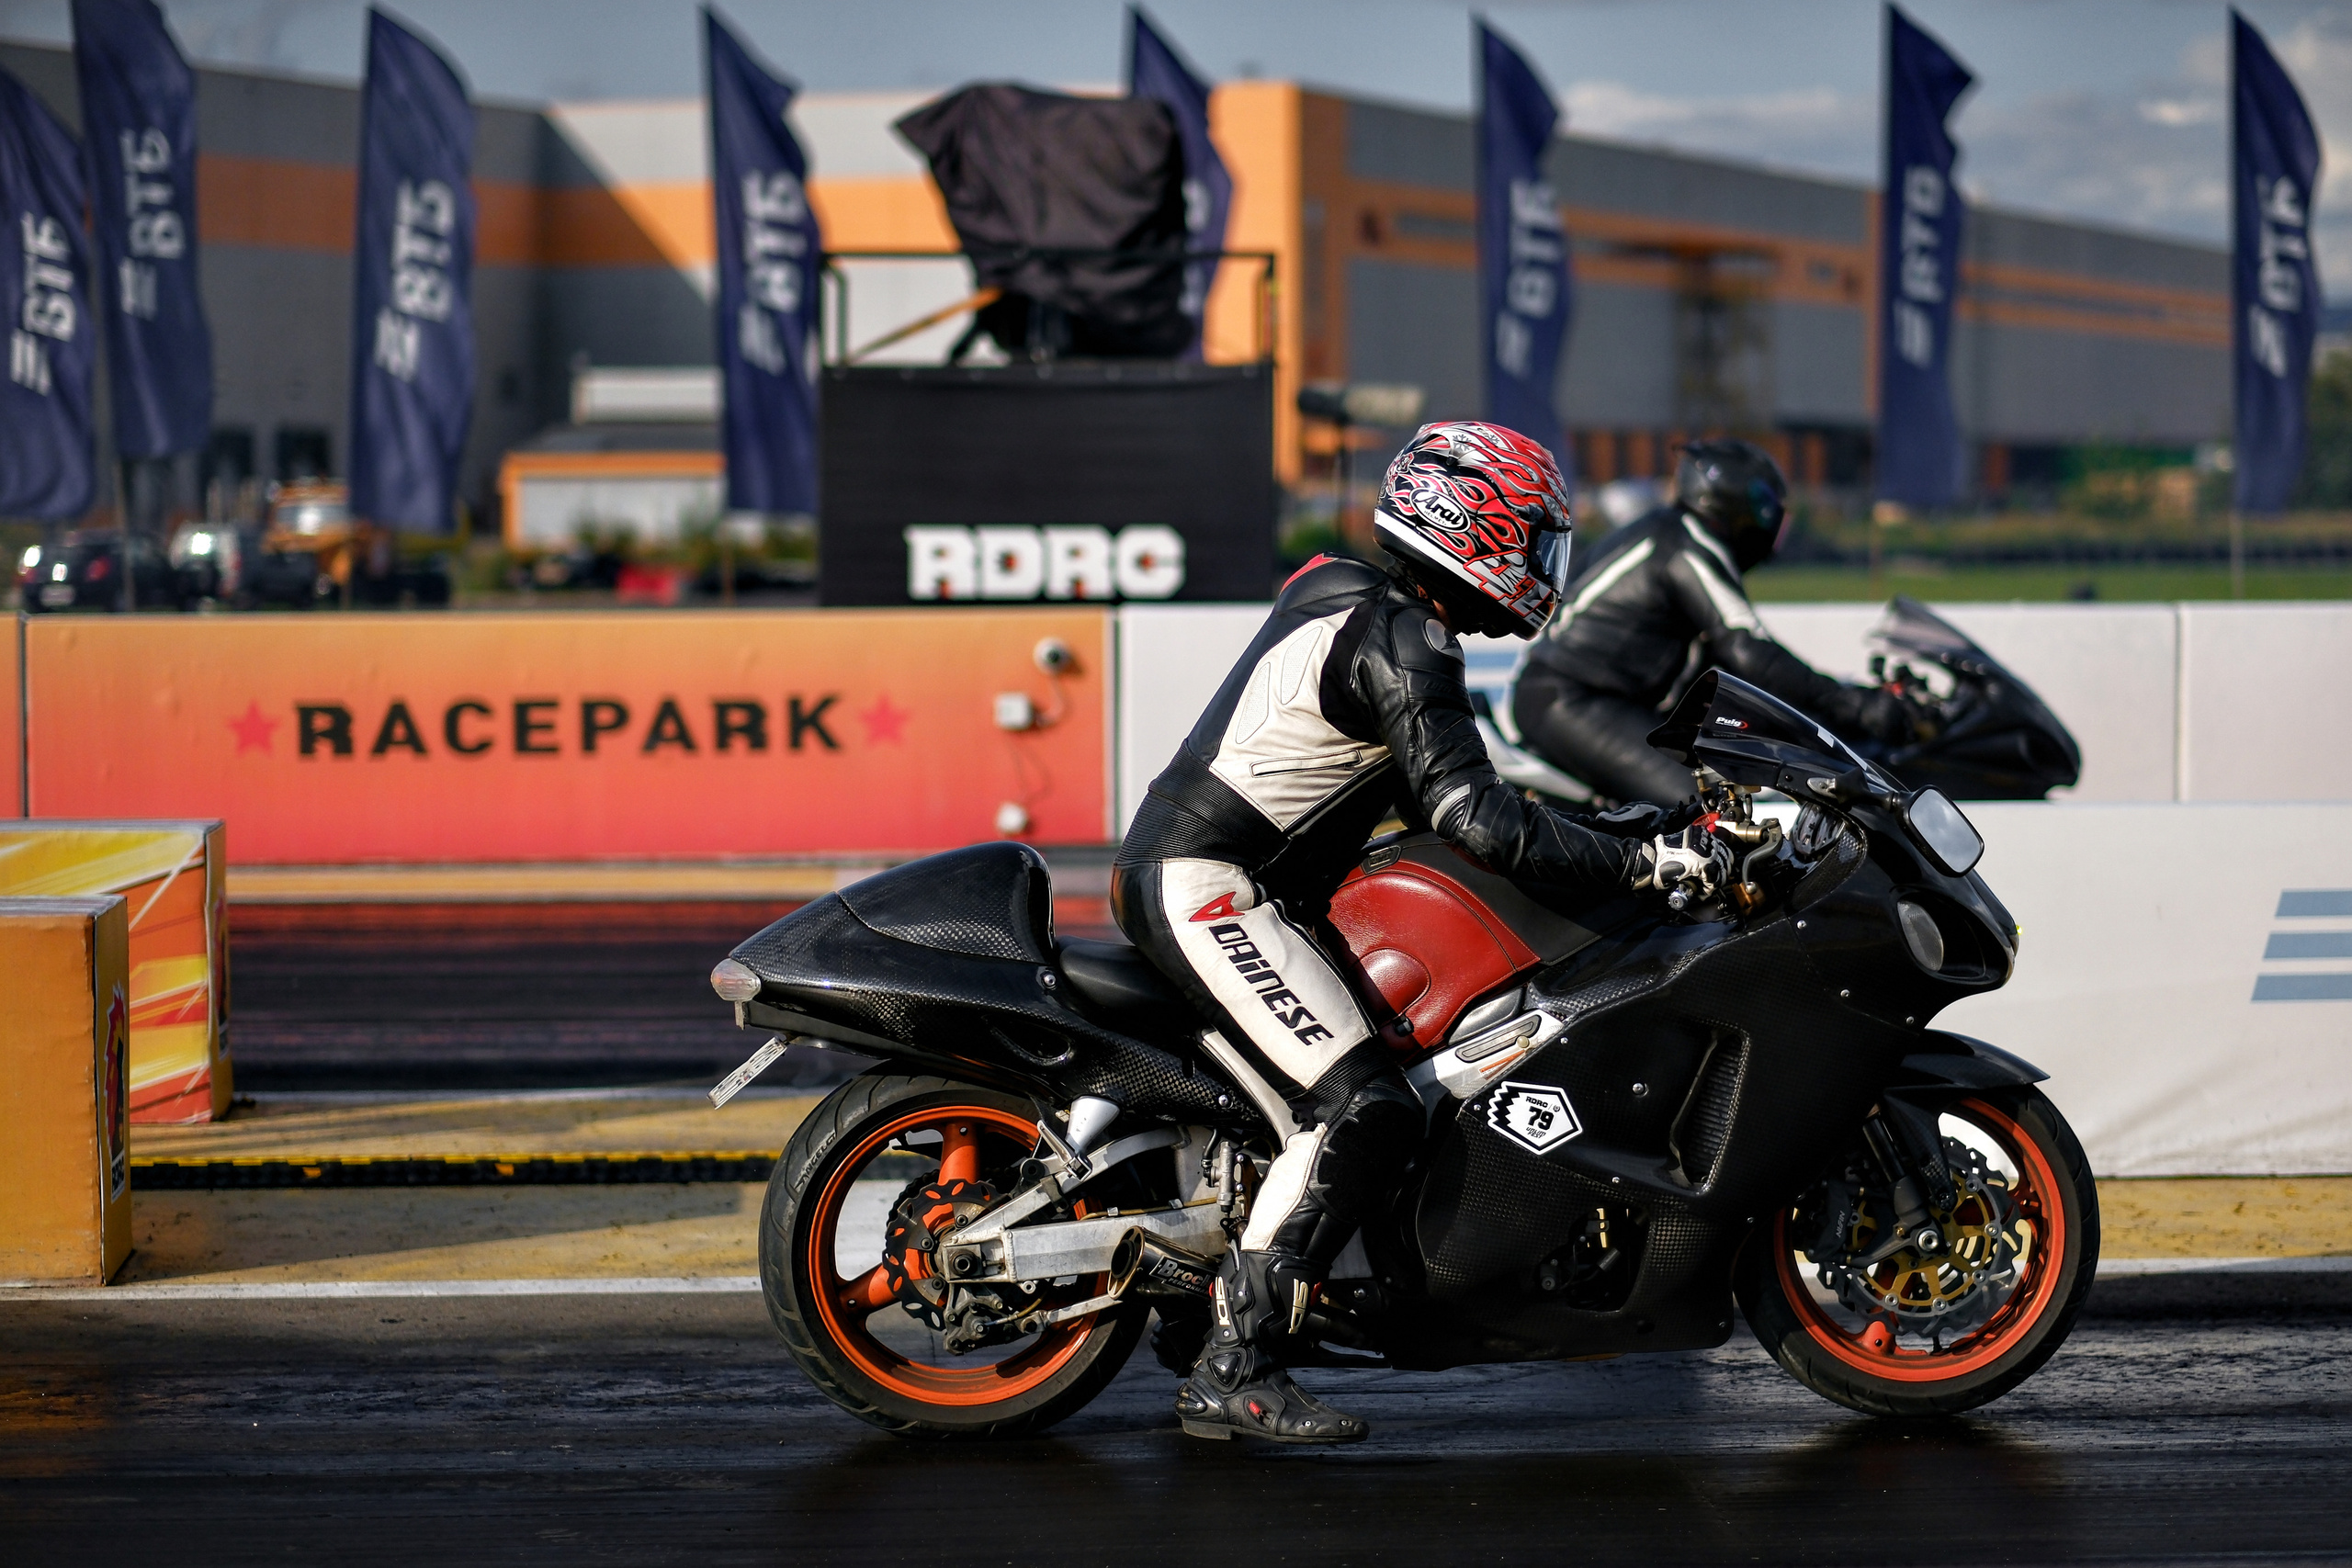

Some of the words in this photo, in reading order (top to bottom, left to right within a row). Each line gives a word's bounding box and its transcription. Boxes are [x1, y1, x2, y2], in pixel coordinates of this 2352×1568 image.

[1414, 495, 1464, 525] Arai
[905, 525, 1184, 599] RDRC
[294, 694, 842, 758] RACEPARK
[1715, 716, 1741, 727] Puig
[1526, 1096, 1548, 1108] RDRC
[1528, 1106, 1554, 1130] 79
[1216, 1276, 1230, 1325] SIDI
[1288, 1278, 1308, 1335] SIDI
